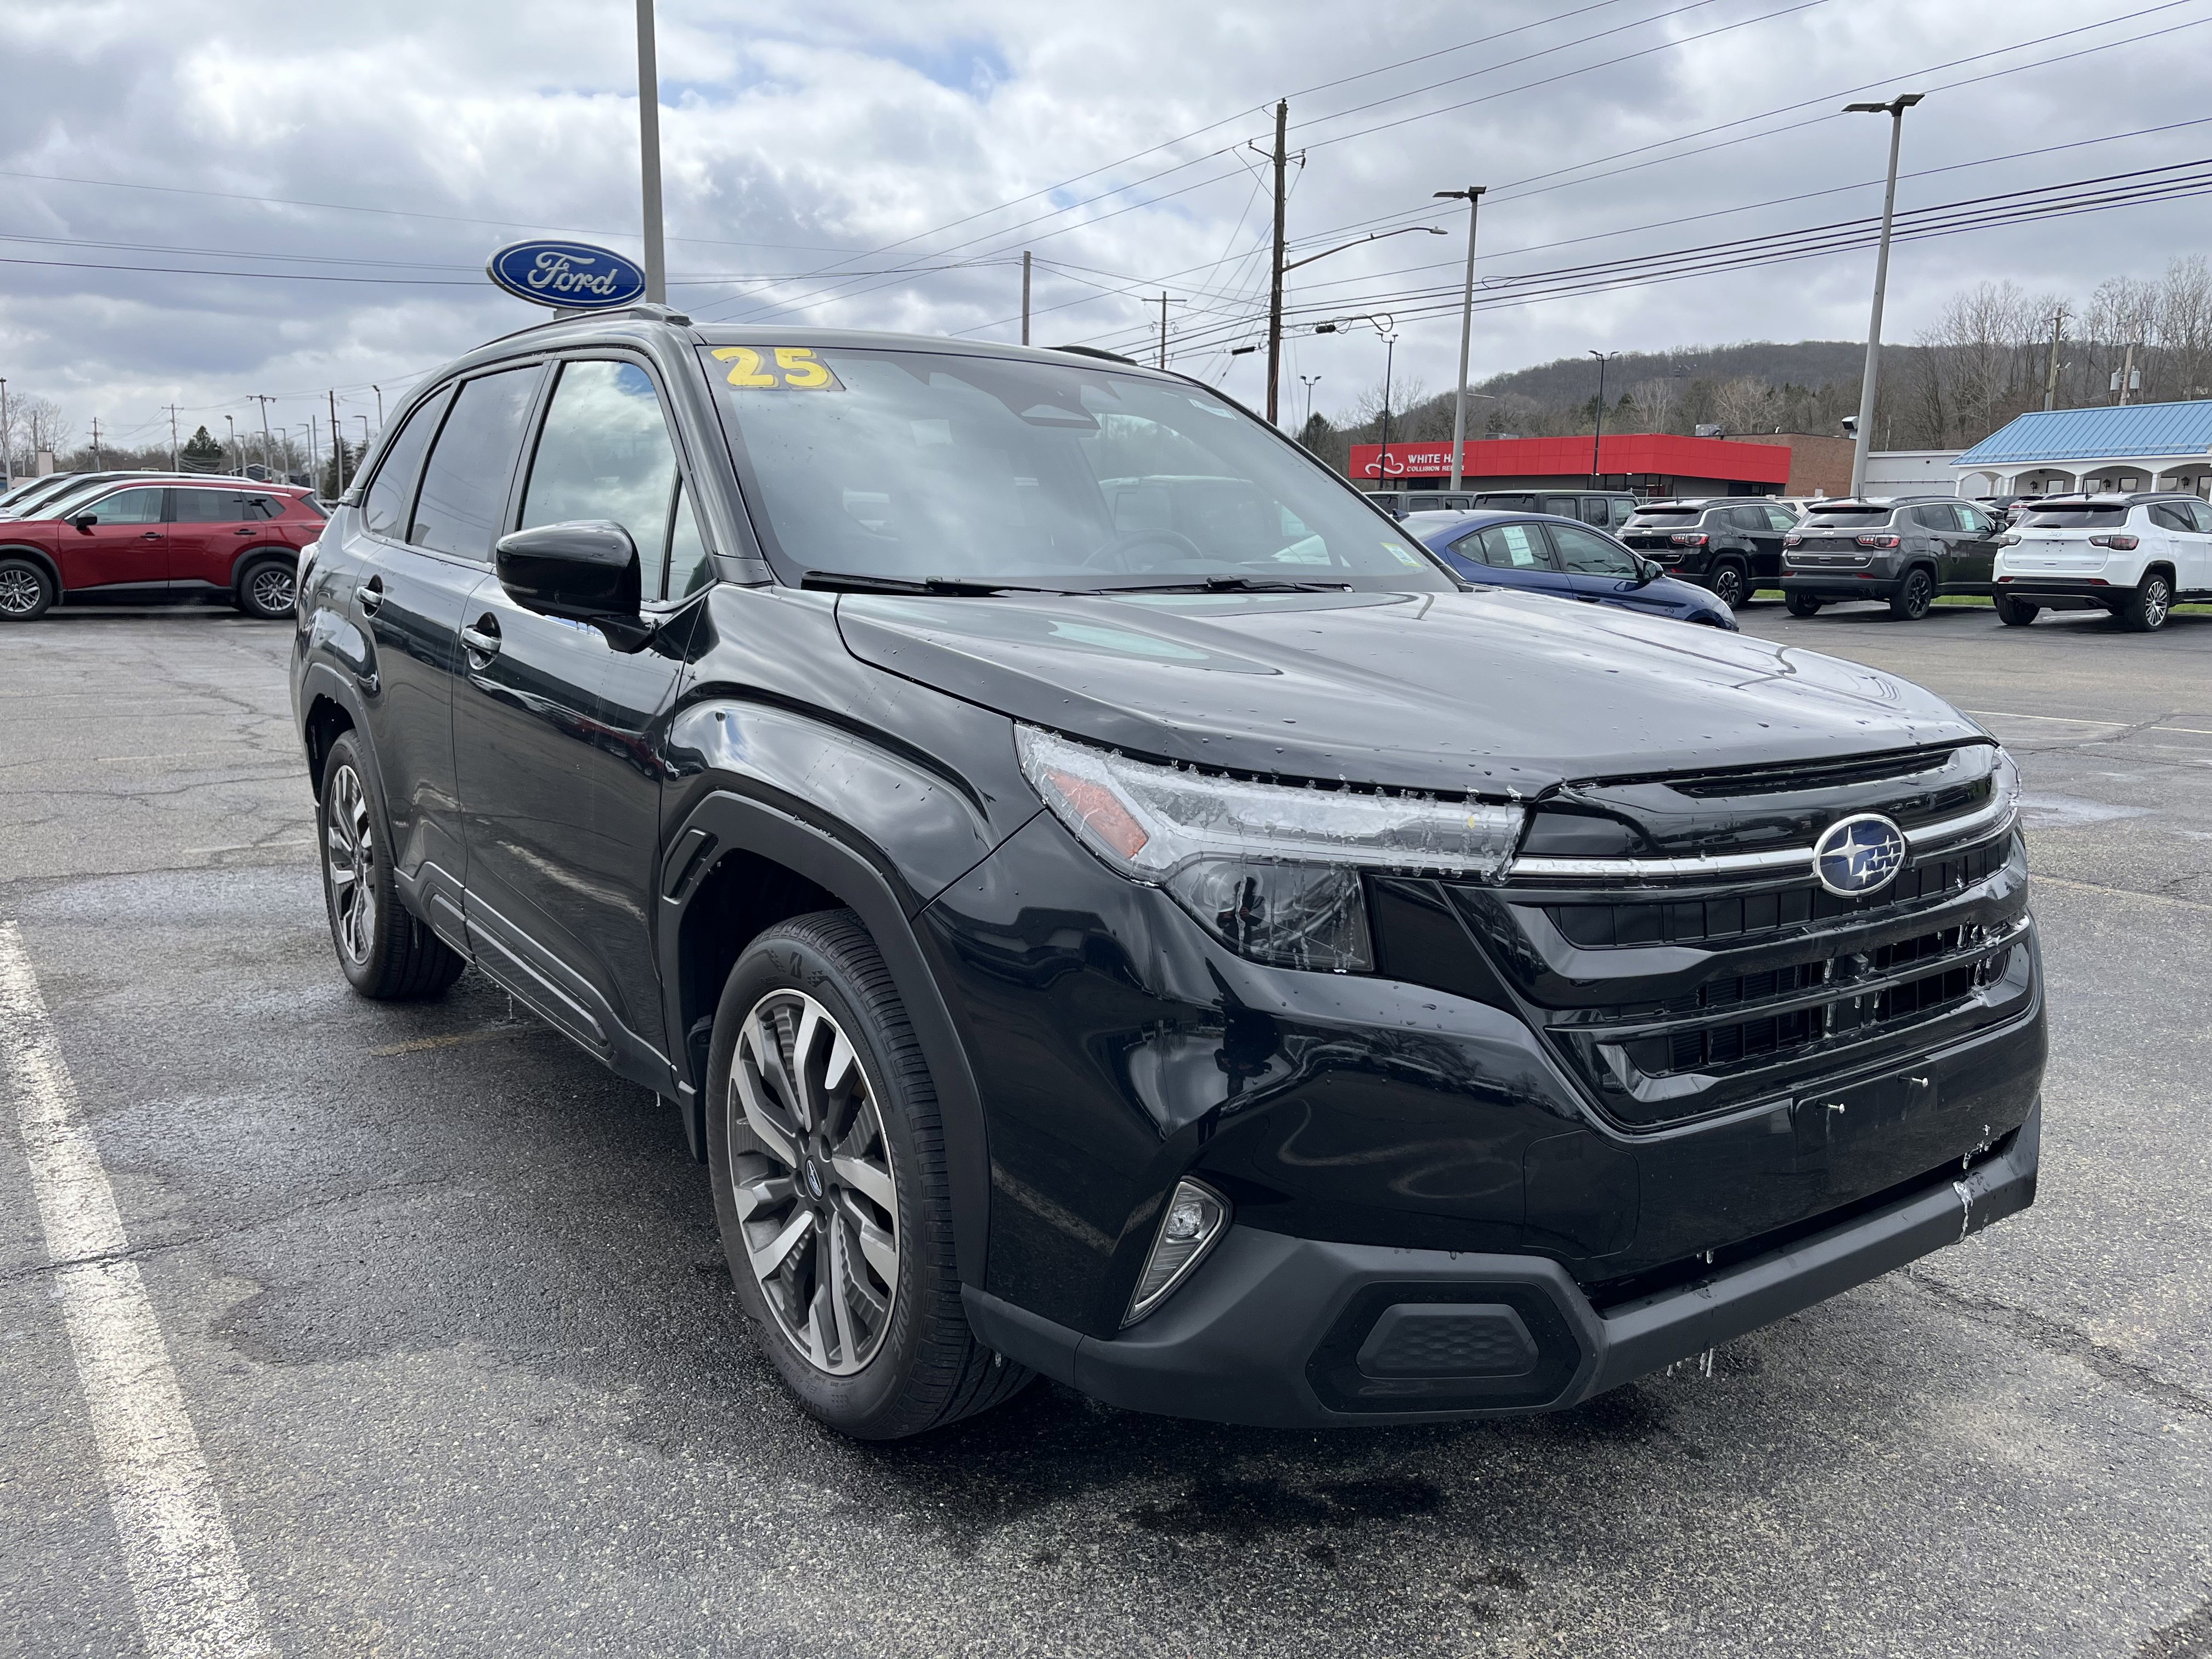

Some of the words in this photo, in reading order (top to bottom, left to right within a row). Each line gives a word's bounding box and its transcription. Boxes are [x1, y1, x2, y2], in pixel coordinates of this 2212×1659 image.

[527, 251, 618, 295] Ford
[711, 347, 832, 388] 25
[1408, 454, 1441, 464] WHITE
